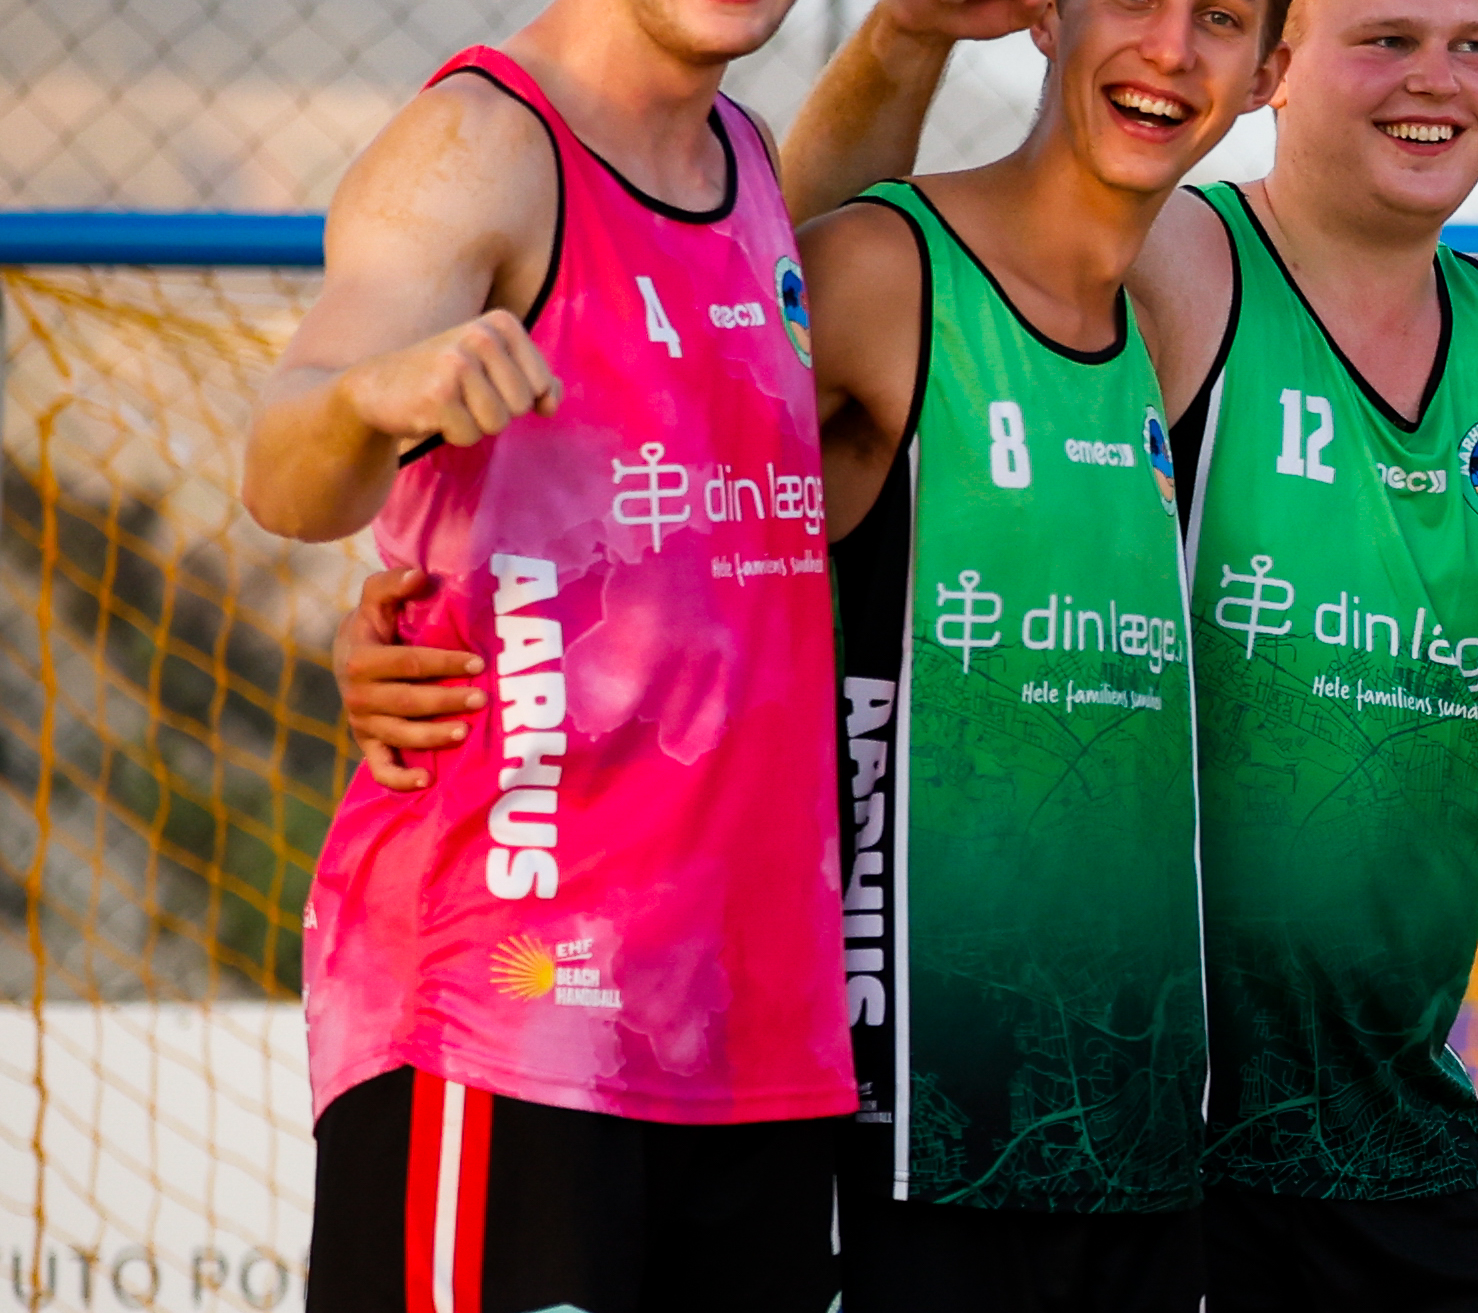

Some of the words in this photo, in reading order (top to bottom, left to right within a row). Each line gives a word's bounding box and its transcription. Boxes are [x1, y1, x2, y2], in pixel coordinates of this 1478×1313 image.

[635, 274, 684, 359] 4
[988, 400, 1033, 489] 8
[1064, 437, 1122, 467] emec
[1276, 387, 1336, 485] 12
[1021, 680, 1060, 705] Hele
[1312, 674, 1350, 701] Hele
[1355, 678, 1433, 716] familiens
[485, 552, 567, 901] AARHUS
[555, 938, 593, 960] EHF
[555, 967, 600, 987] BEACH
